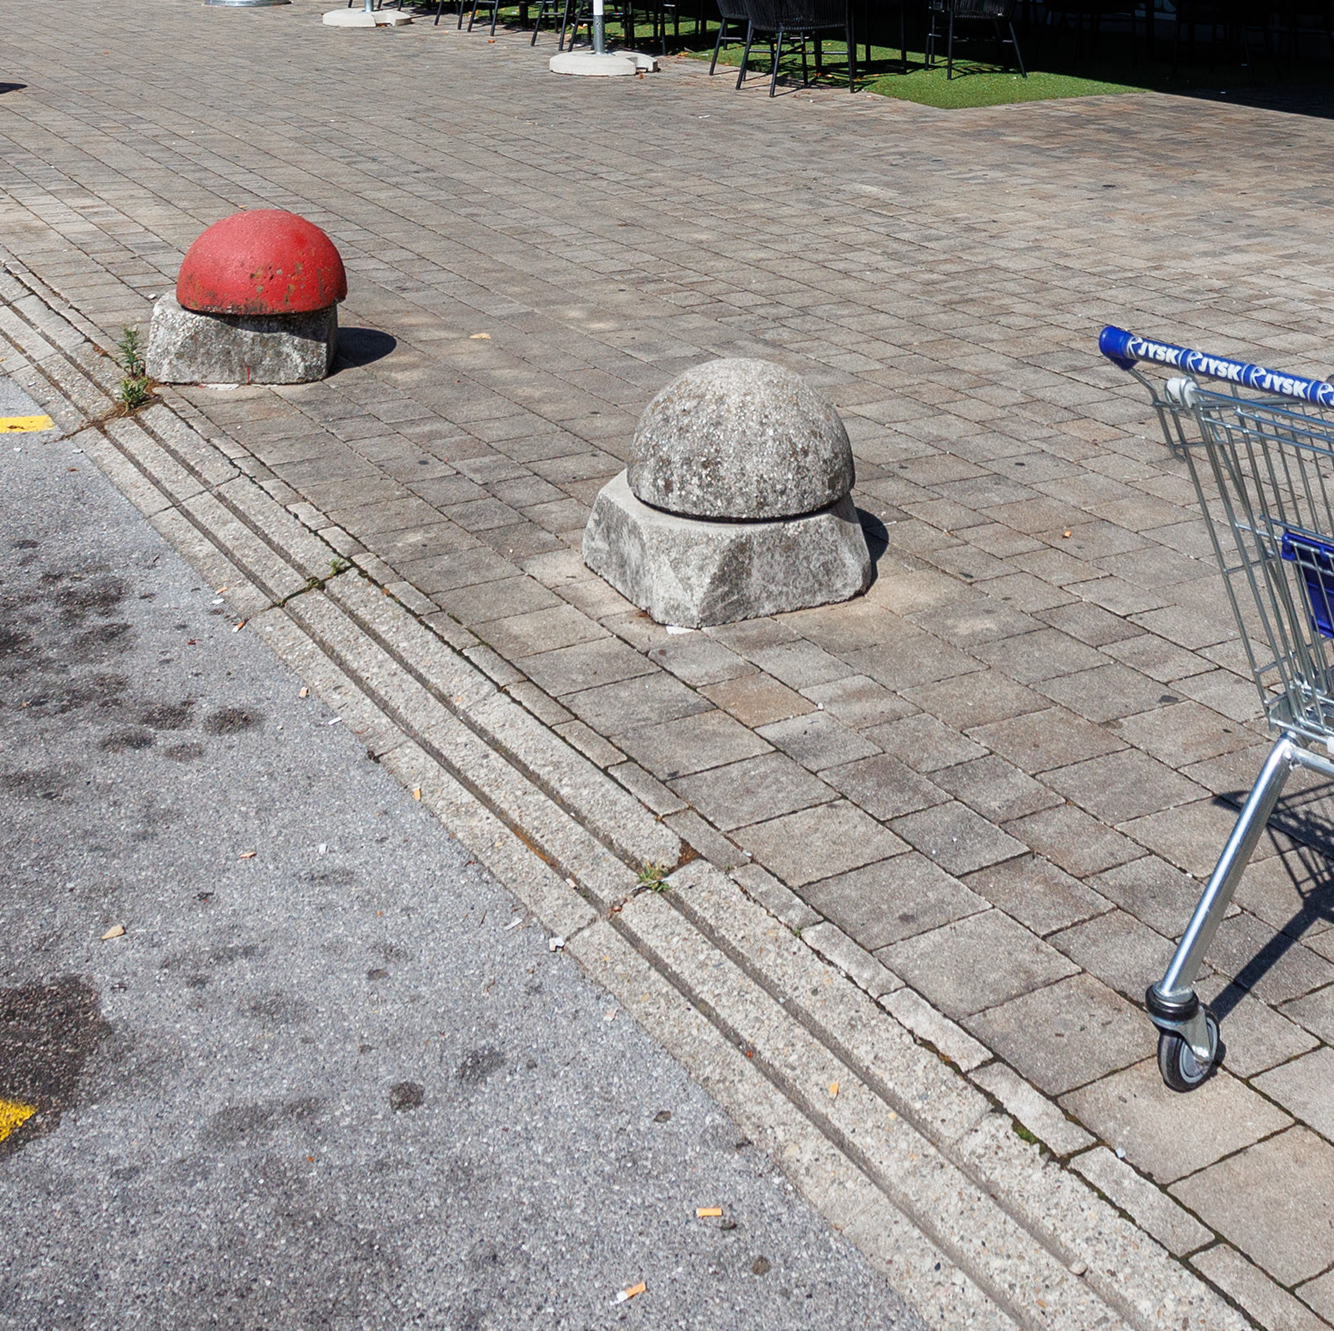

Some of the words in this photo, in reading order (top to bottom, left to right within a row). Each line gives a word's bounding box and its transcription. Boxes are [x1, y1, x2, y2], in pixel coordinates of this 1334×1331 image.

[1137, 337, 1179, 365] JYSK
[1197, 355, 1242, 382] JYSK
[1261, 372, 1308, 399] JYSK
